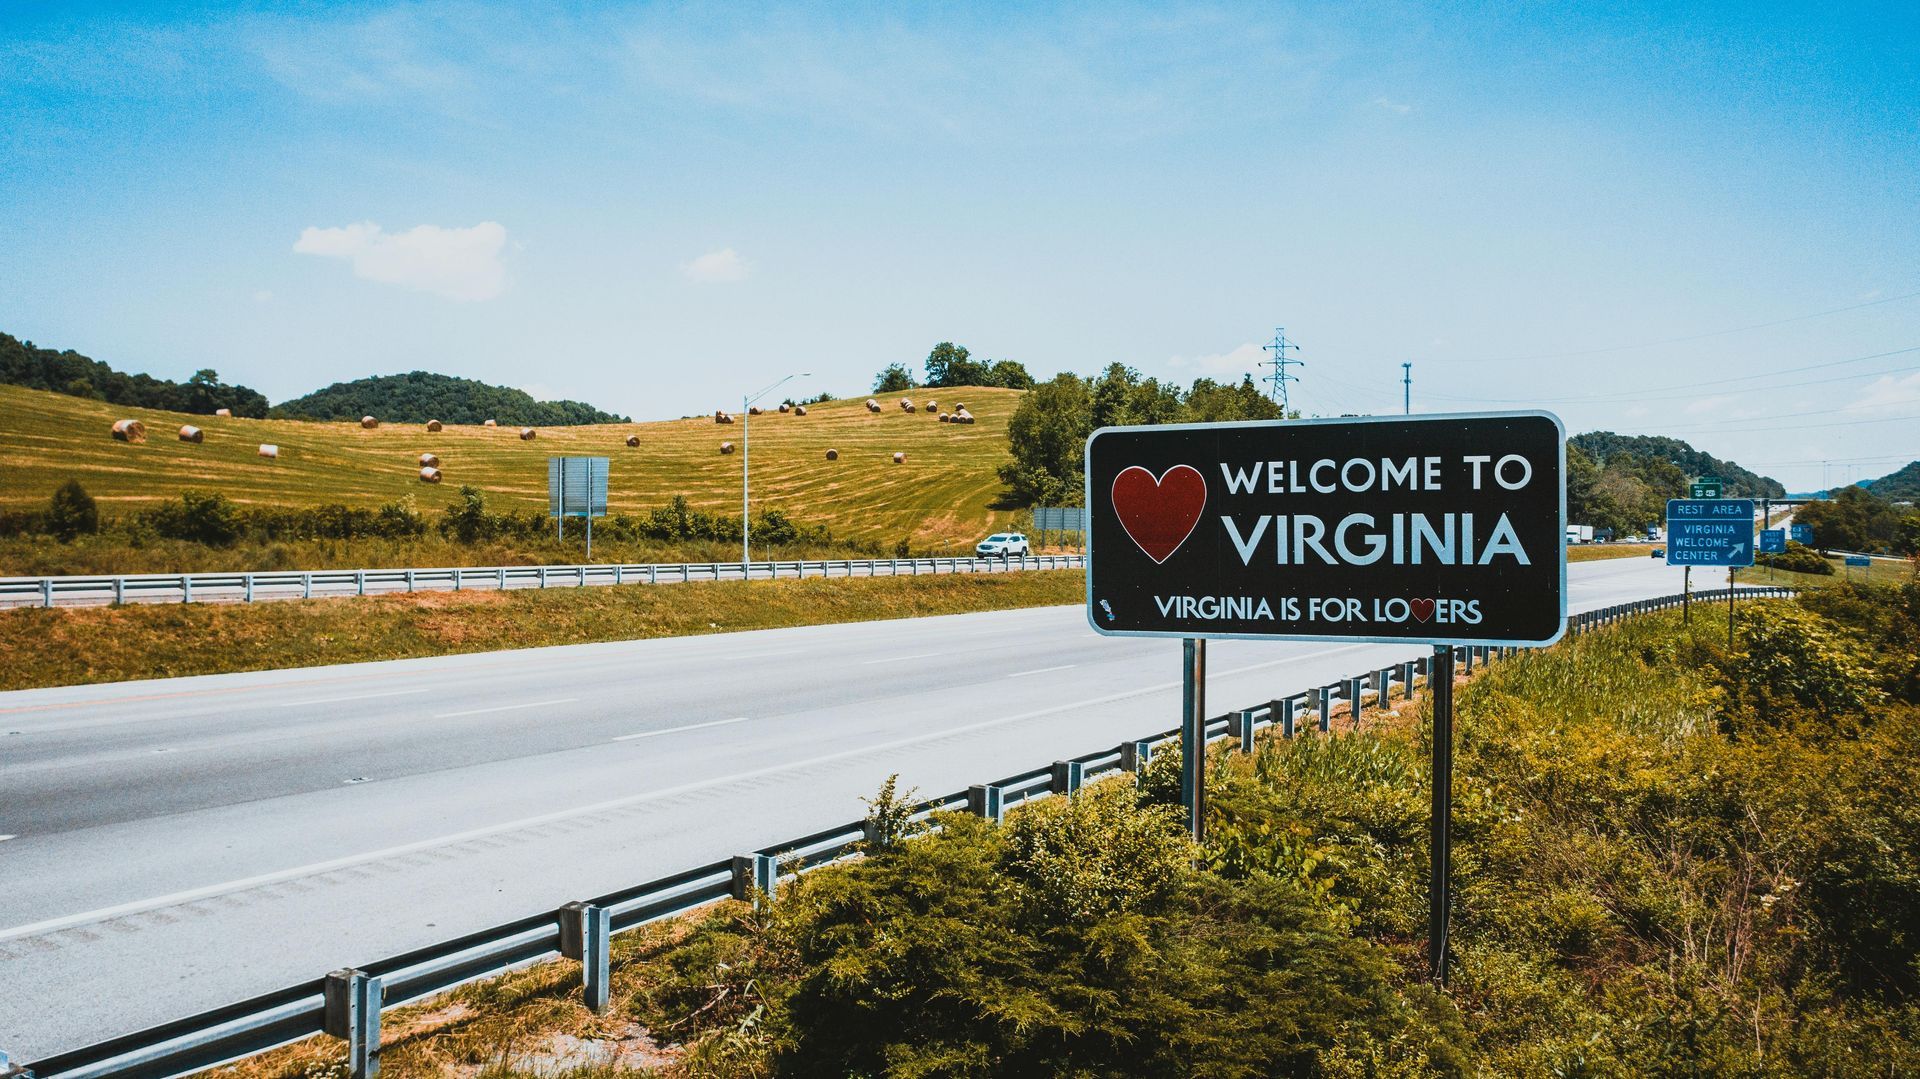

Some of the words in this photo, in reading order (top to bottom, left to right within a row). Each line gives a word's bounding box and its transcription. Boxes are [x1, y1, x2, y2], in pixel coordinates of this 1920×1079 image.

[1219, 457, 1441, 494] WELCOME
[1463, 454, 1532, 490] TO
[1677, 505, 1704, 515] REST
[1712, 505, 1742, 515] AREA
[1684, 525, 1736, 534] VIRGINIA
[1220, 512, 1532, 566] VIRGINIA
[1675, 538, 1729, 547] WELCOME
[1675, 551, 1718, 560] CENTER
[1154, 595, 1275, 620] VIRGINIA
[1281, 597, 1301, 621] IS
[1309, 598, 1368, 622] FOR
[1374, 598, 1482, 624] LOERS
